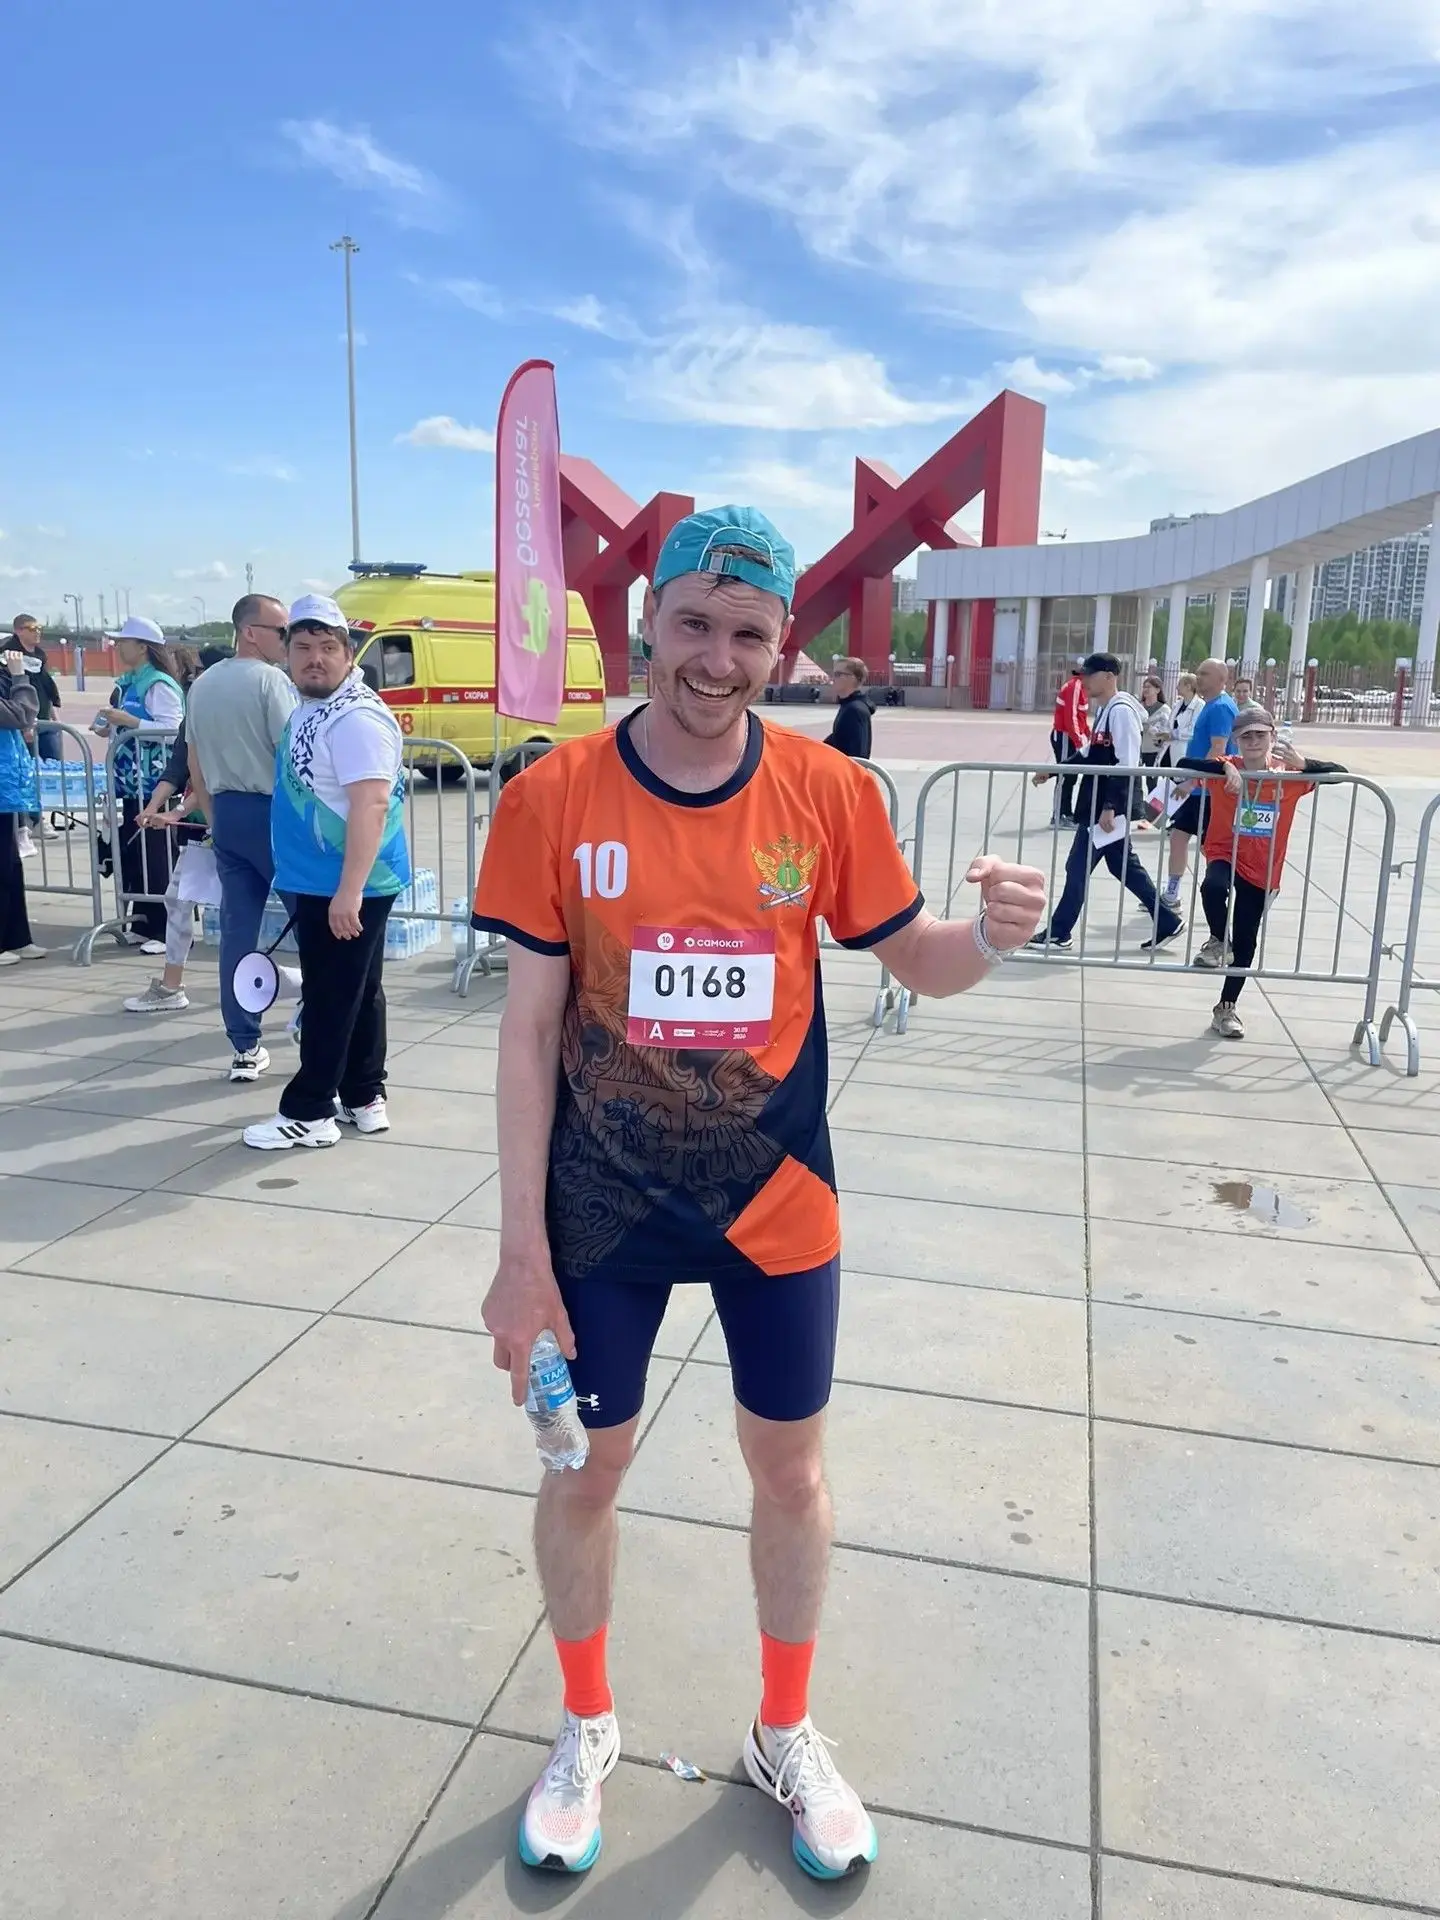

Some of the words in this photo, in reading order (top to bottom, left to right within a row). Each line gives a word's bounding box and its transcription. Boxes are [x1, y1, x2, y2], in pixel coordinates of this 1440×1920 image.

[464, 691, 489, 700] СКОРАЯ
[568, 691, 592, 700] ПОМОЩЬ
[573, 840, 628, 899] 10
[662, 936, 671, 944] 10
[697, 939, 744, 948] самокат
[655, 964, 746, 998] 0168
